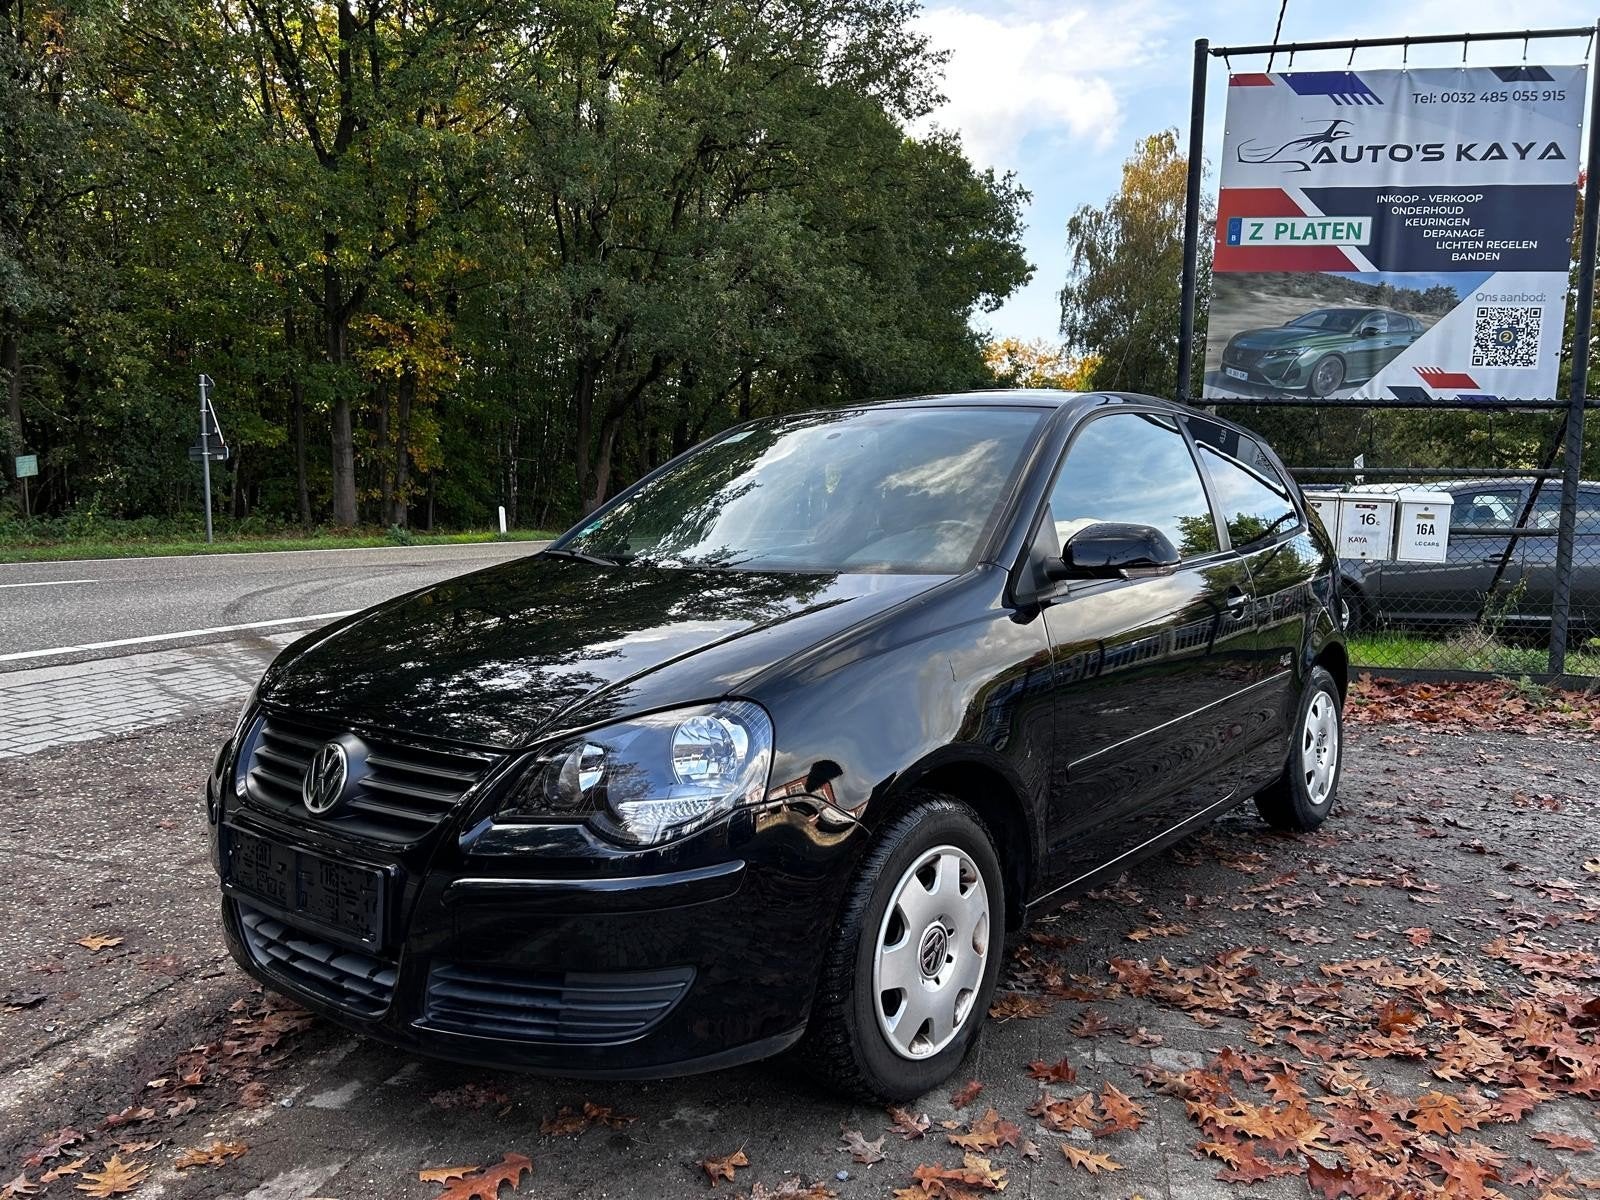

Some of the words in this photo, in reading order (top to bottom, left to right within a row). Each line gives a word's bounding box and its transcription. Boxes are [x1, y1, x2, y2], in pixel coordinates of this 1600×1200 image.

[1412, 92, 1437, 104] Tel:
[1440, 92, 1476, 104] 0032
[1480, 91, 1508, 103] 485
[1512, 90, 1538, 102] 055
[1542, 90, 1566, 101] 915
[1310, 143, 1445, 164] AUTO'S
[1456, 141, 1567, 162] KAYA
[1376, 194, 1419, 204] INKOOP
[1428, 194, 1484, 203] VERKOOP
[1391, 206, 1464, 215] ONDERHOUD
[1404, 217, 1471, 227] KEURINGEN
[1248, 222, 1265, 241] Z
[1274, 221, 1363, 241] PLATEN
[1423, 228, 1486, 238] DEPANAGE
[1231, 234, 1236, 242] B
[1436, 240, 1484, 250] LICHTEN
[1486, 240, 1538, 249] REGELEN
[1451, 252, 1501, 261] BANDEN
[1475, 292, 1498, 302] Ons
[1500, 292, 1546, 302] aanbod:
[1416, 523, 1435, 536] 16A
[1348, 536, 1368, 544] KAYA
